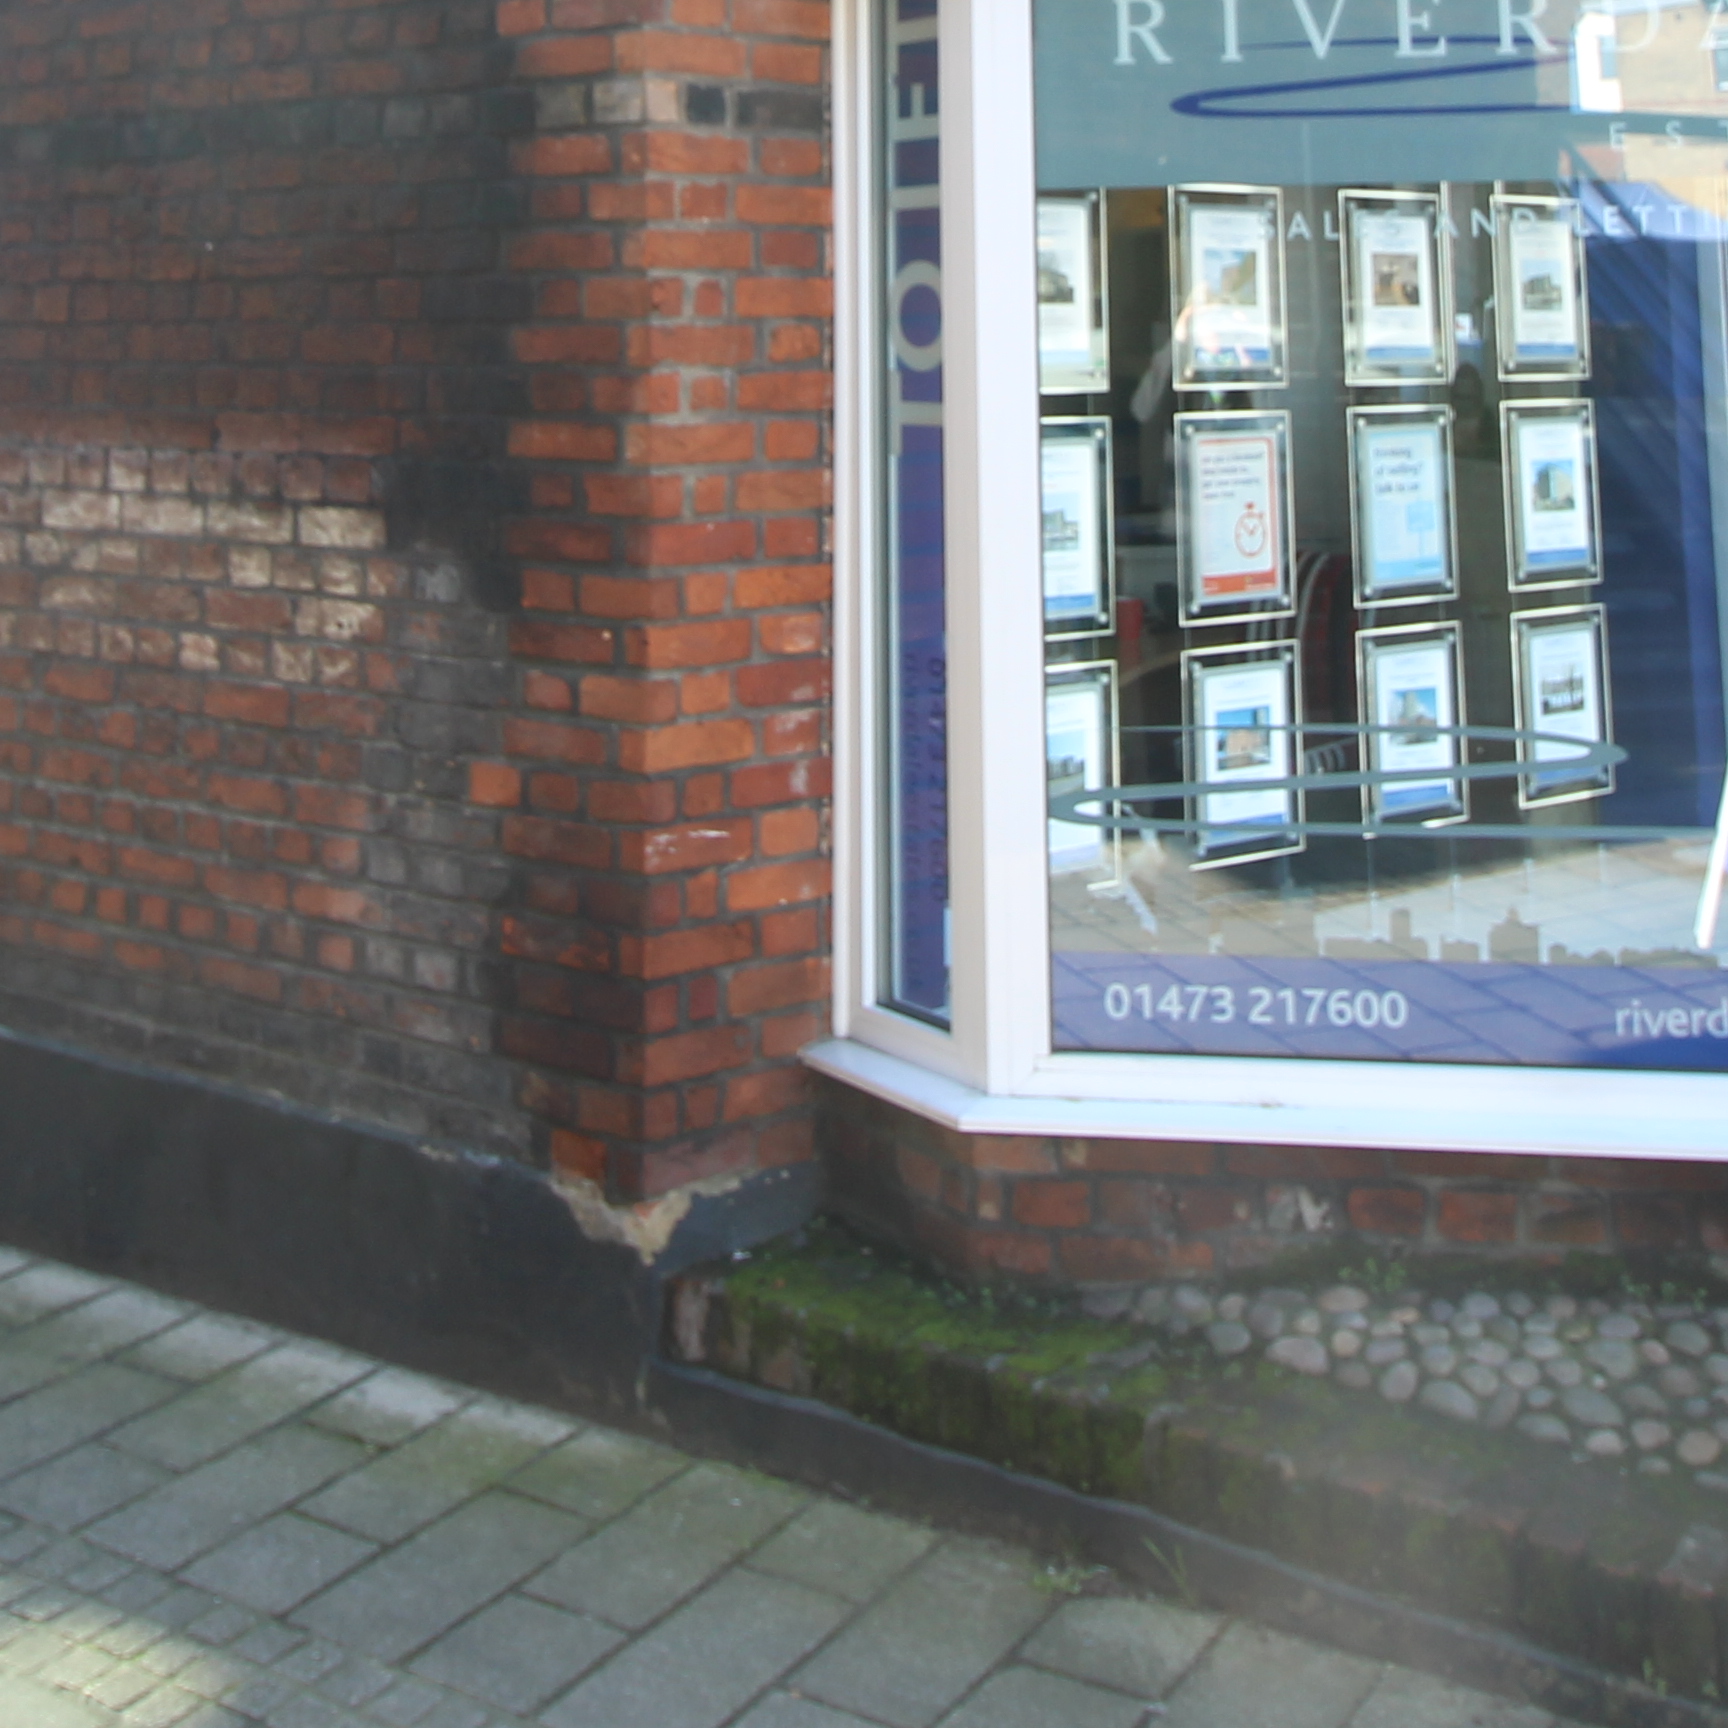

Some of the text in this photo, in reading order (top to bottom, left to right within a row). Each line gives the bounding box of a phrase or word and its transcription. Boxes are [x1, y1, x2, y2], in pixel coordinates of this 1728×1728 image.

[1256, 209, 1403, 241] SALES
[1431, 207, 1539, 239] AND
[1104, 982, 1409, 1029] 01473 217600
